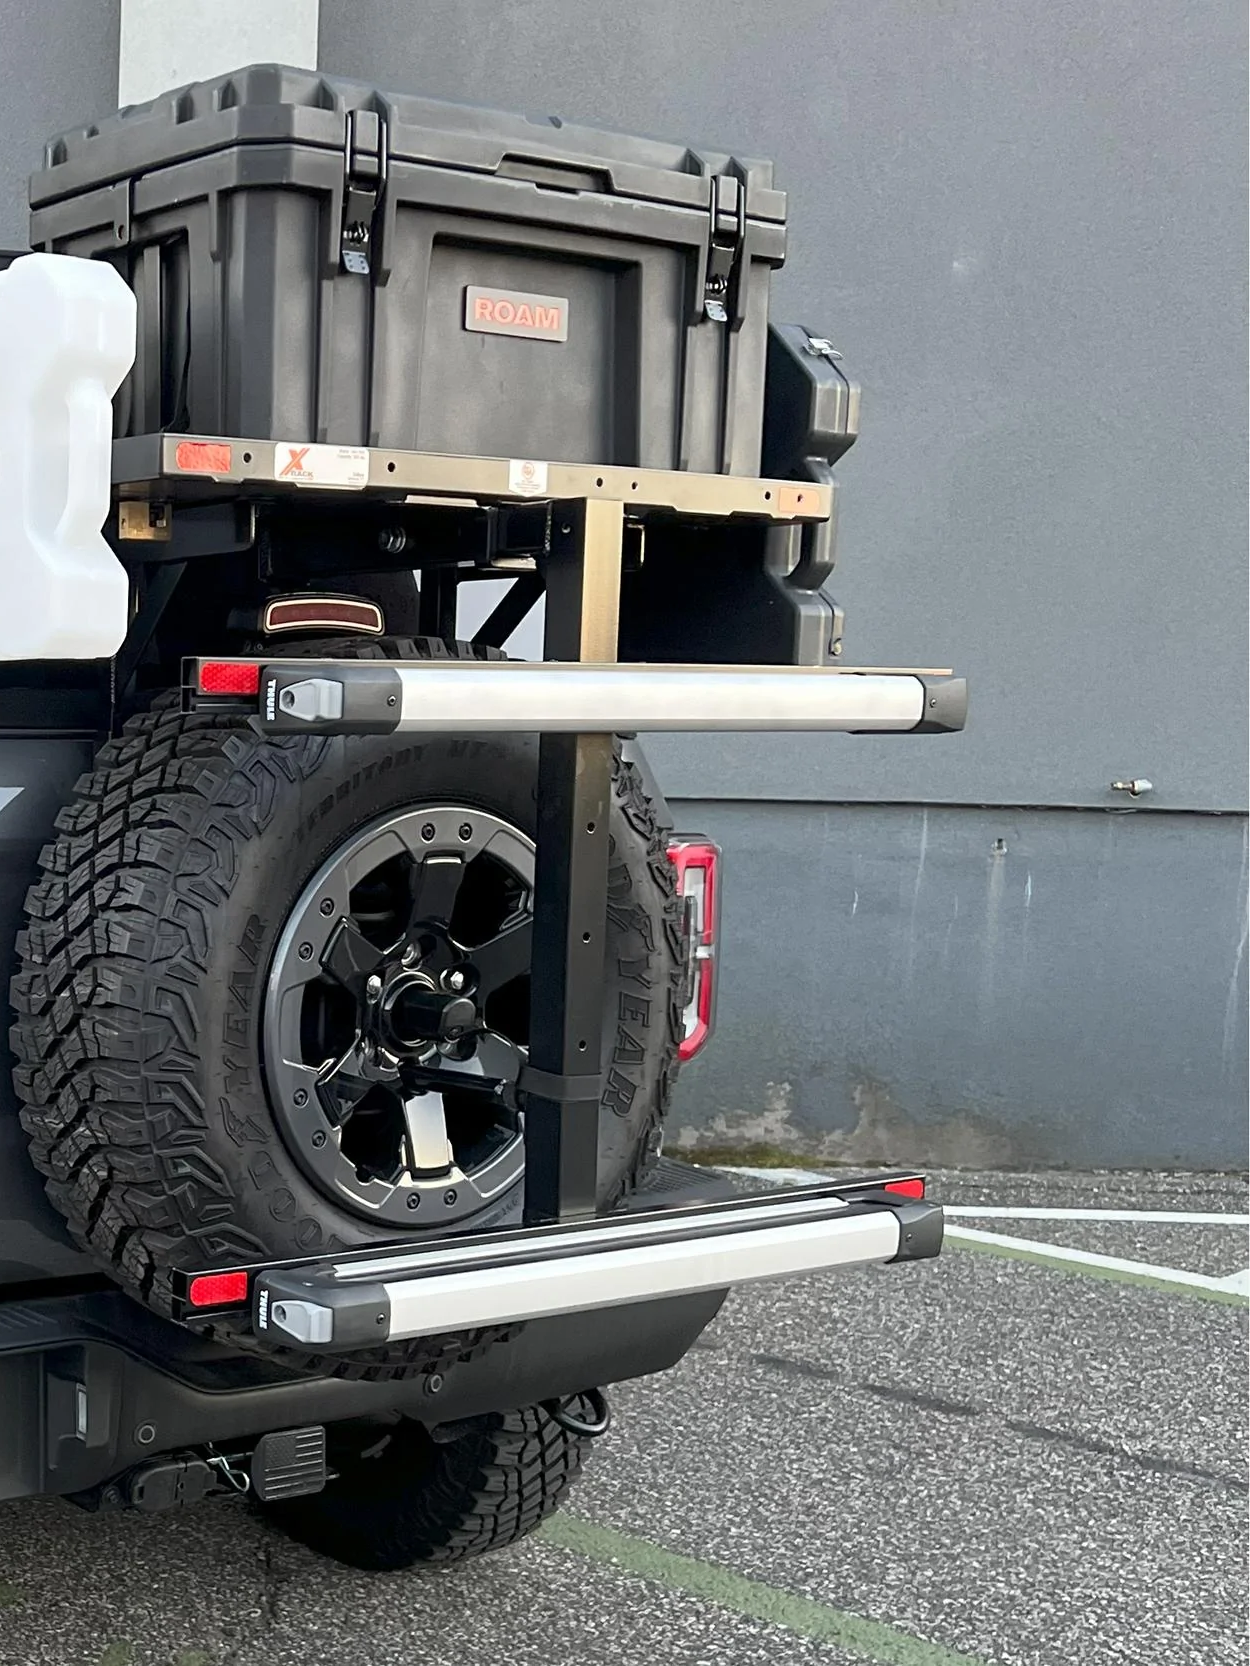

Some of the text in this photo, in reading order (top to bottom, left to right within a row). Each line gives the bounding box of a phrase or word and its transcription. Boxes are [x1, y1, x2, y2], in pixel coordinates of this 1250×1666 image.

[474, 298, 560, 331] ROAM
[266, 679, 277, 721] THULE
[259, 1290, 269, 1330] THULE
